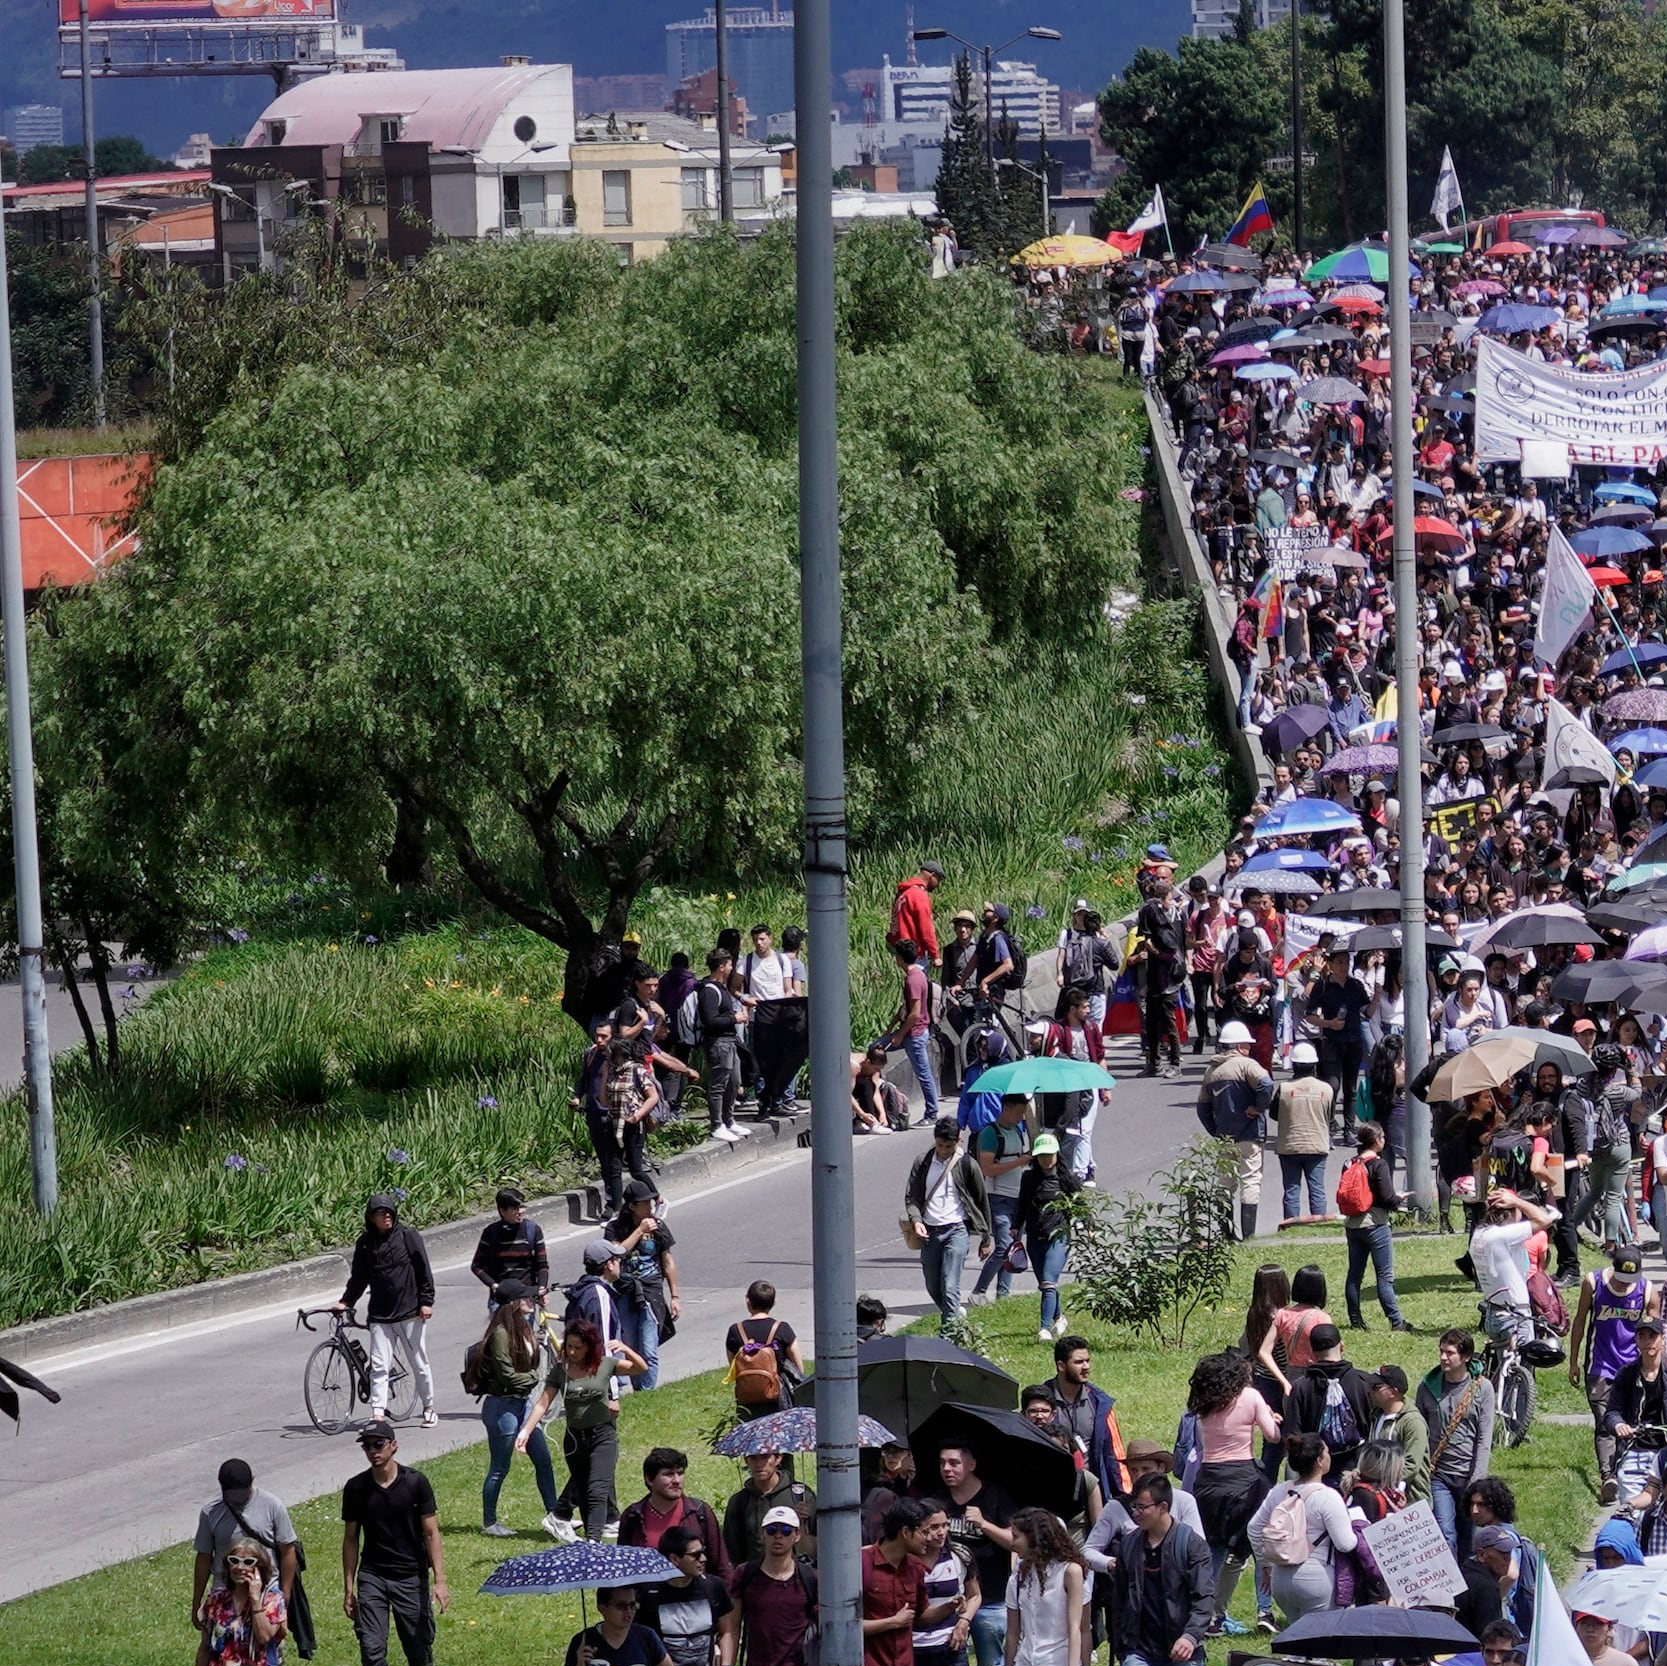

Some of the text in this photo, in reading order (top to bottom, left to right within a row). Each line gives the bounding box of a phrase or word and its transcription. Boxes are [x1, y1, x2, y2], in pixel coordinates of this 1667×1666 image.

[1575, 386, 1618, 401] SOLO
[1624, 385, 1658, 401] CON
[1531, 412, 1623, 434] DERROTAR
[1629, 420, 1649, 433] EL
[1592, 443, 1616, 464] EL
[1264, 527, 1278, 538] NO
[1281, 527, 1292, 538] LE
[1295, 526, 1319, 537] TEMO
[1264, 539, 1275, 549] LA
[1381, 1510, 1420, 1535] YO NO
[1404, 1569, 1447, 1594] COLOMBIA
